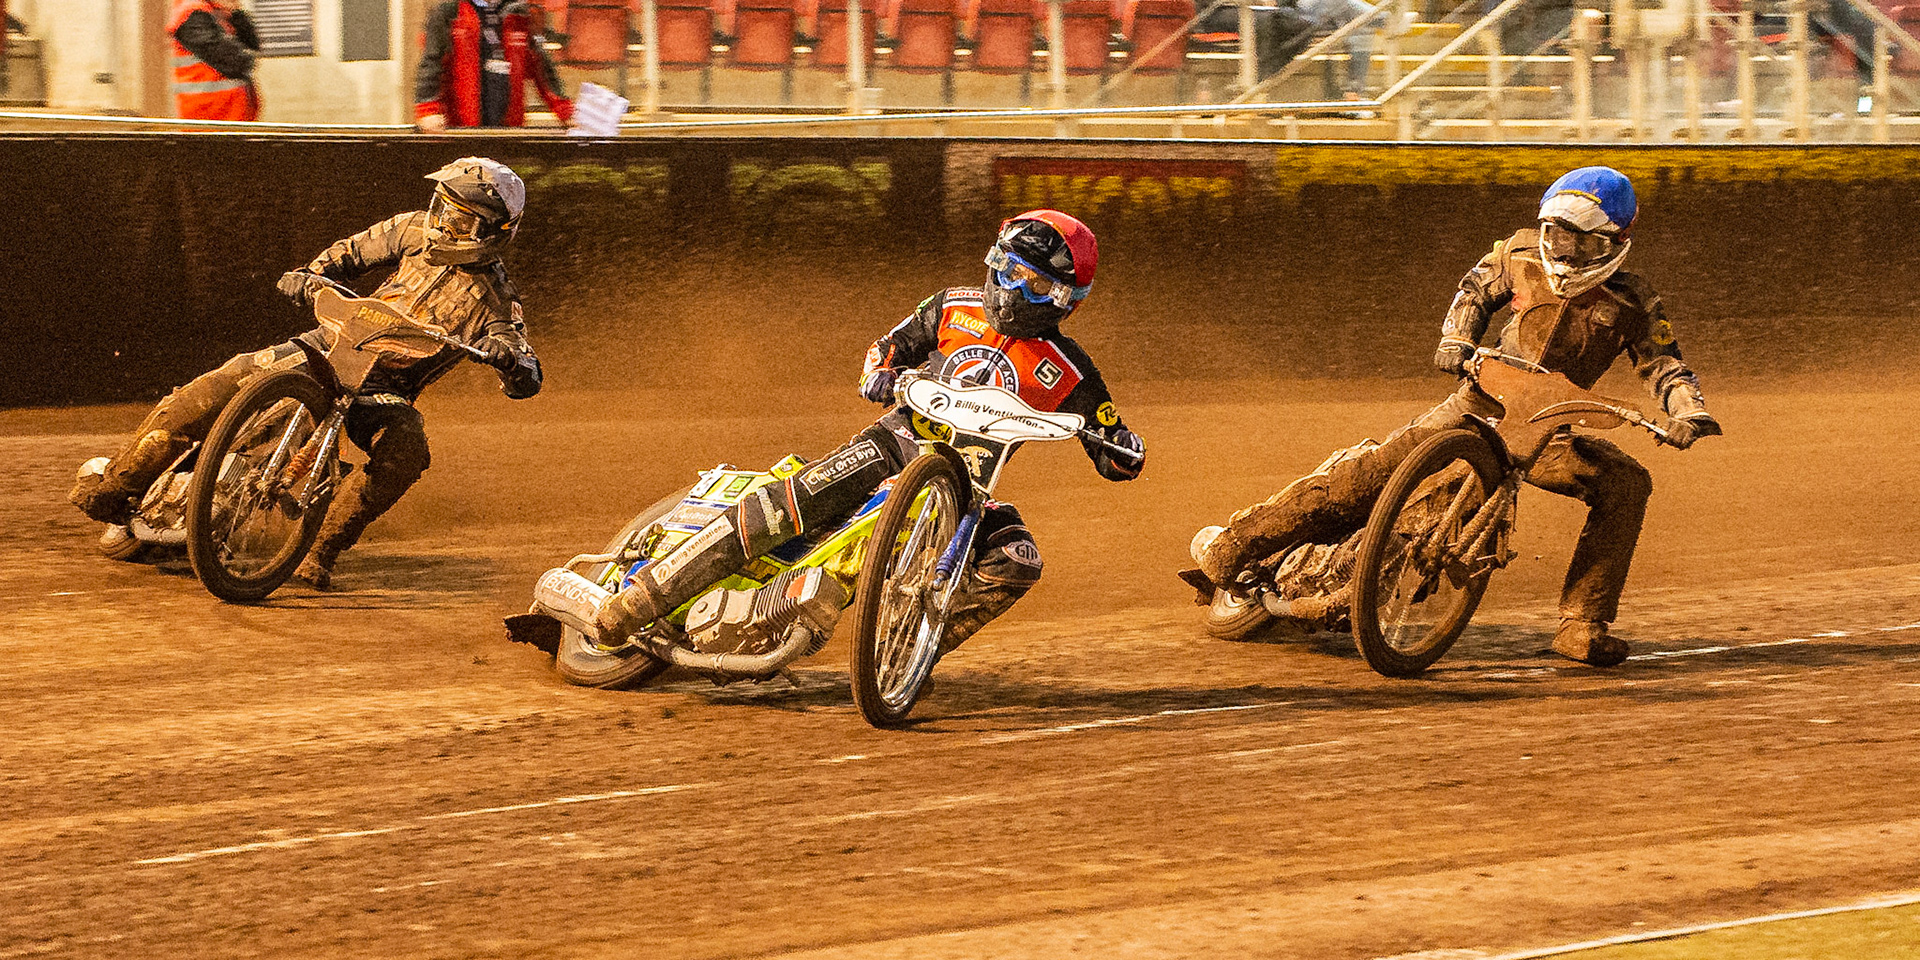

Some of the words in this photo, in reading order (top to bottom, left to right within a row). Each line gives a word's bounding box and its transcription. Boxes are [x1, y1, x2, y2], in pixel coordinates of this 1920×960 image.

[950, 310, 988, 333] HYCOTE
[952, 349, 983, 365] BELLE
[1037, 362, 1059, 383] 5
[806, 466, 836, 485] Claus
[855, 447, 876, 461] Byg
[544, 576, 590, 604] BLINDS
